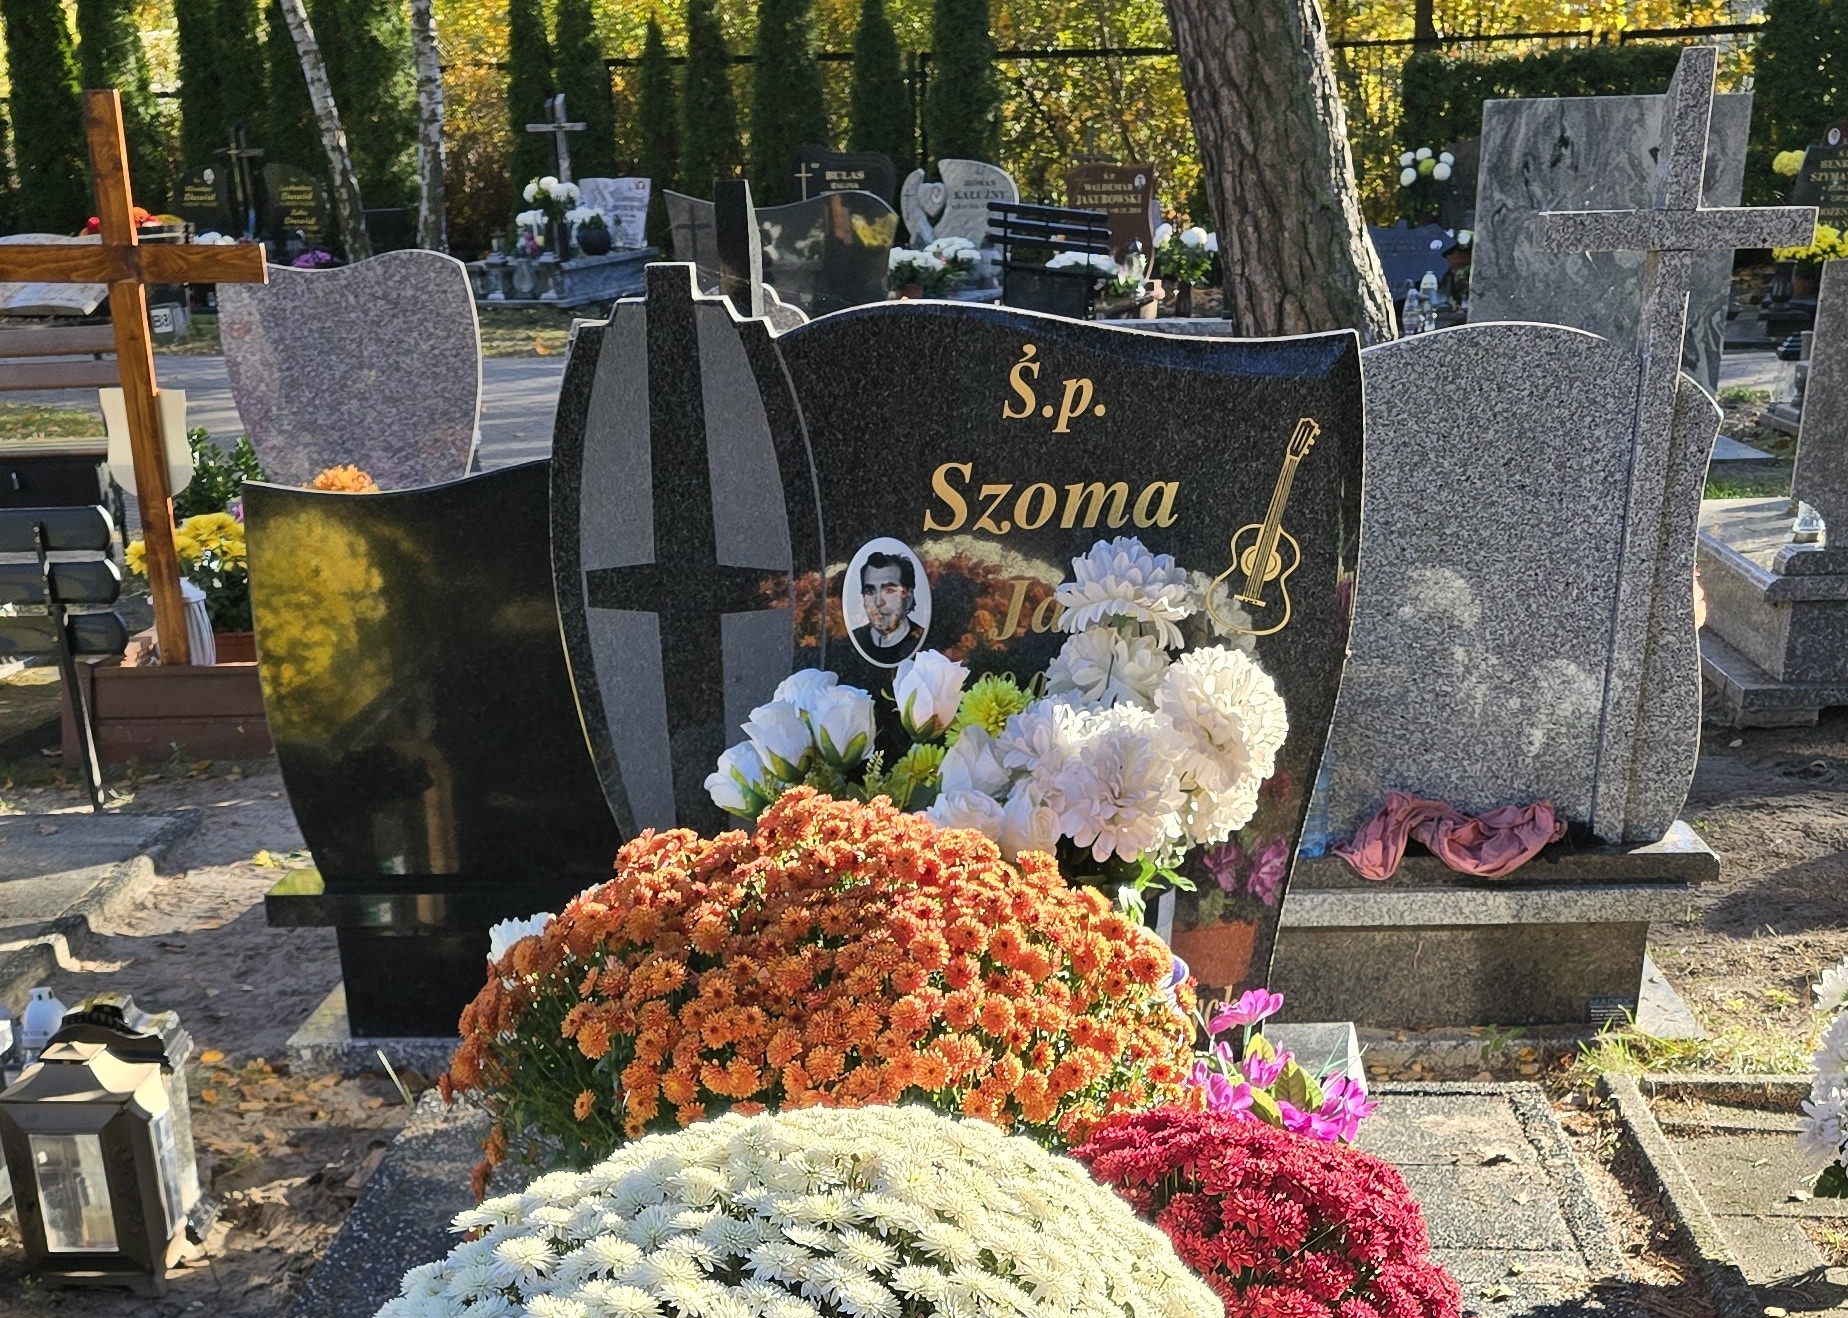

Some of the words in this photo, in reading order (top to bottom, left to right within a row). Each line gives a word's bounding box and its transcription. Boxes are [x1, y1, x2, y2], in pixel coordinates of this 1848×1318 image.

[1003, 344, 1106, 433] Ś.p.
[923, 462, 1179, 535] Szoma
[988, 579, 1066, 641] Ja
